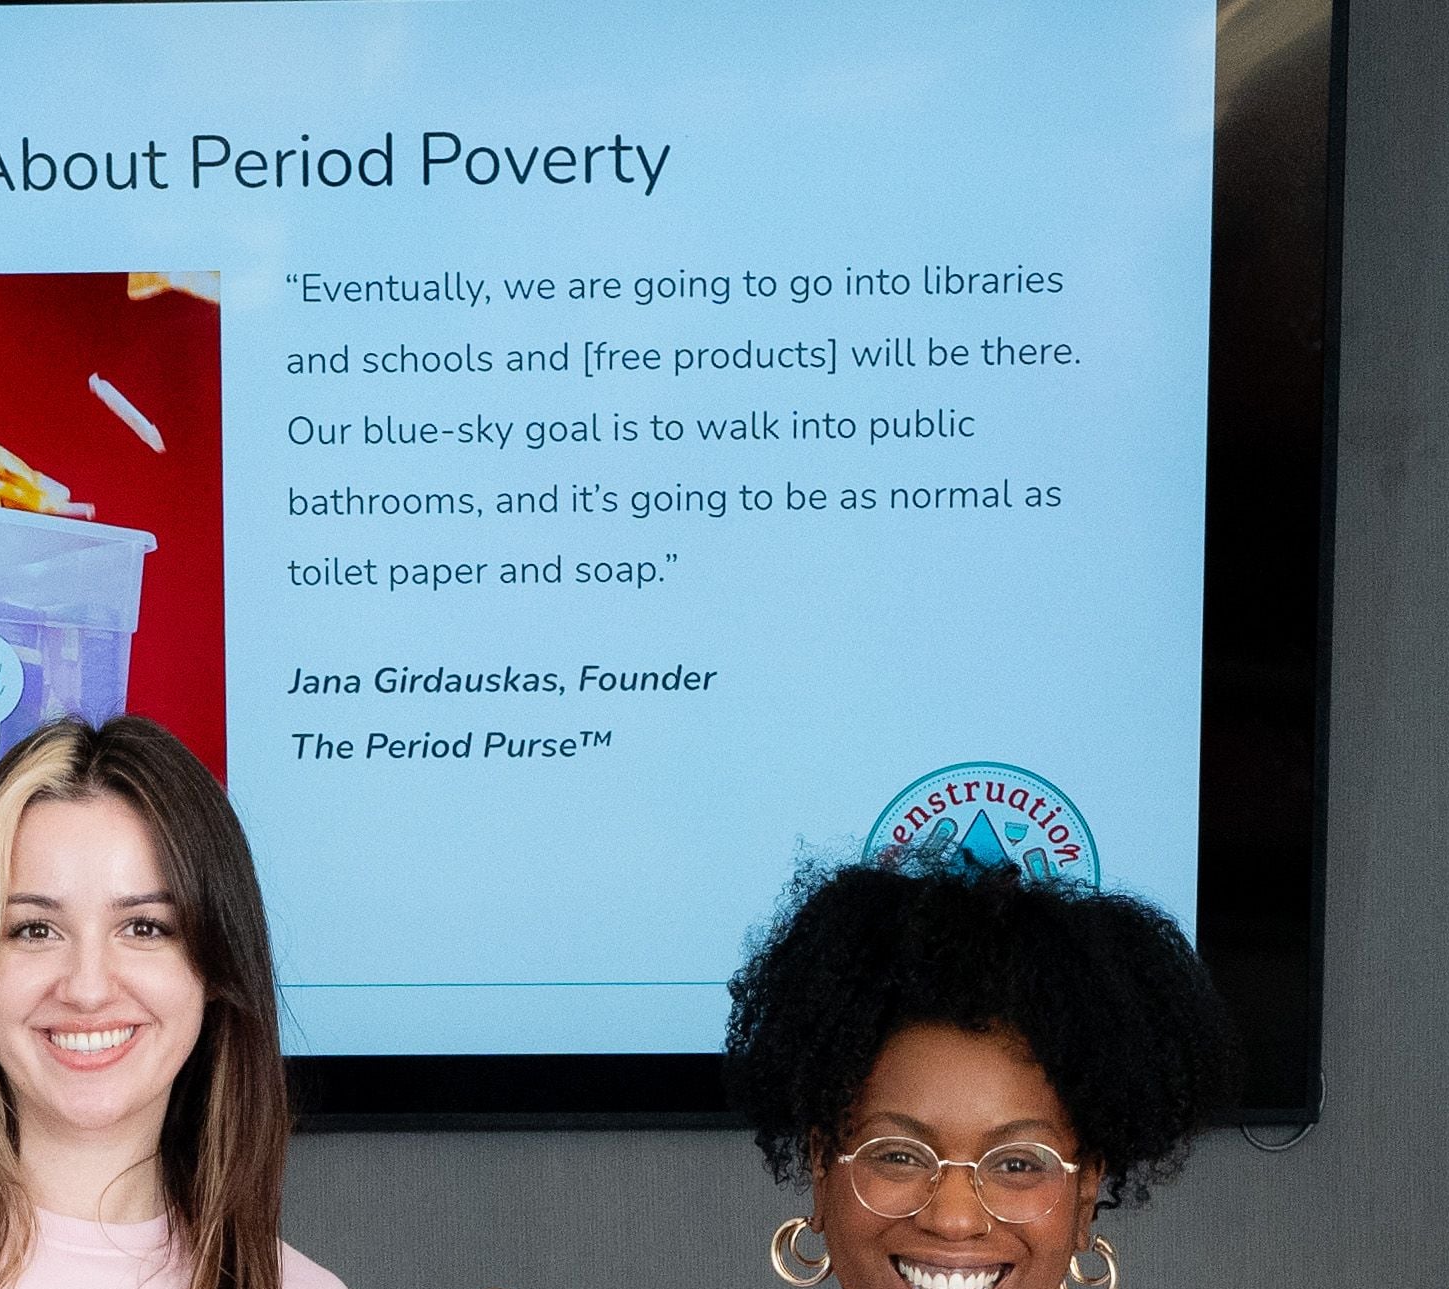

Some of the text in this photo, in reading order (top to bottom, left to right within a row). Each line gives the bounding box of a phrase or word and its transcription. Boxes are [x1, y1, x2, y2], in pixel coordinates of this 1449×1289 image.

[193, 132, 392, 188] Period
[423, 132, 670, 196] Poverty
[286, 265, 1063, 307] “Eventually, we are going to go into libraries
[287, 337, 1080, 377] and schools and [free products] will be there.
[288, 409, 974, 449] Our blue-sky goal is to walk into public
[289, 479, 1061, 519] bathrooms, and it’s going to be as normal as
[288, 554, 677, 591] toilet paper and soap.”
[288, 665, 717, 695] Jana Girdauskas, Founder
[292, 731, 612, 759] The Period Purse™
